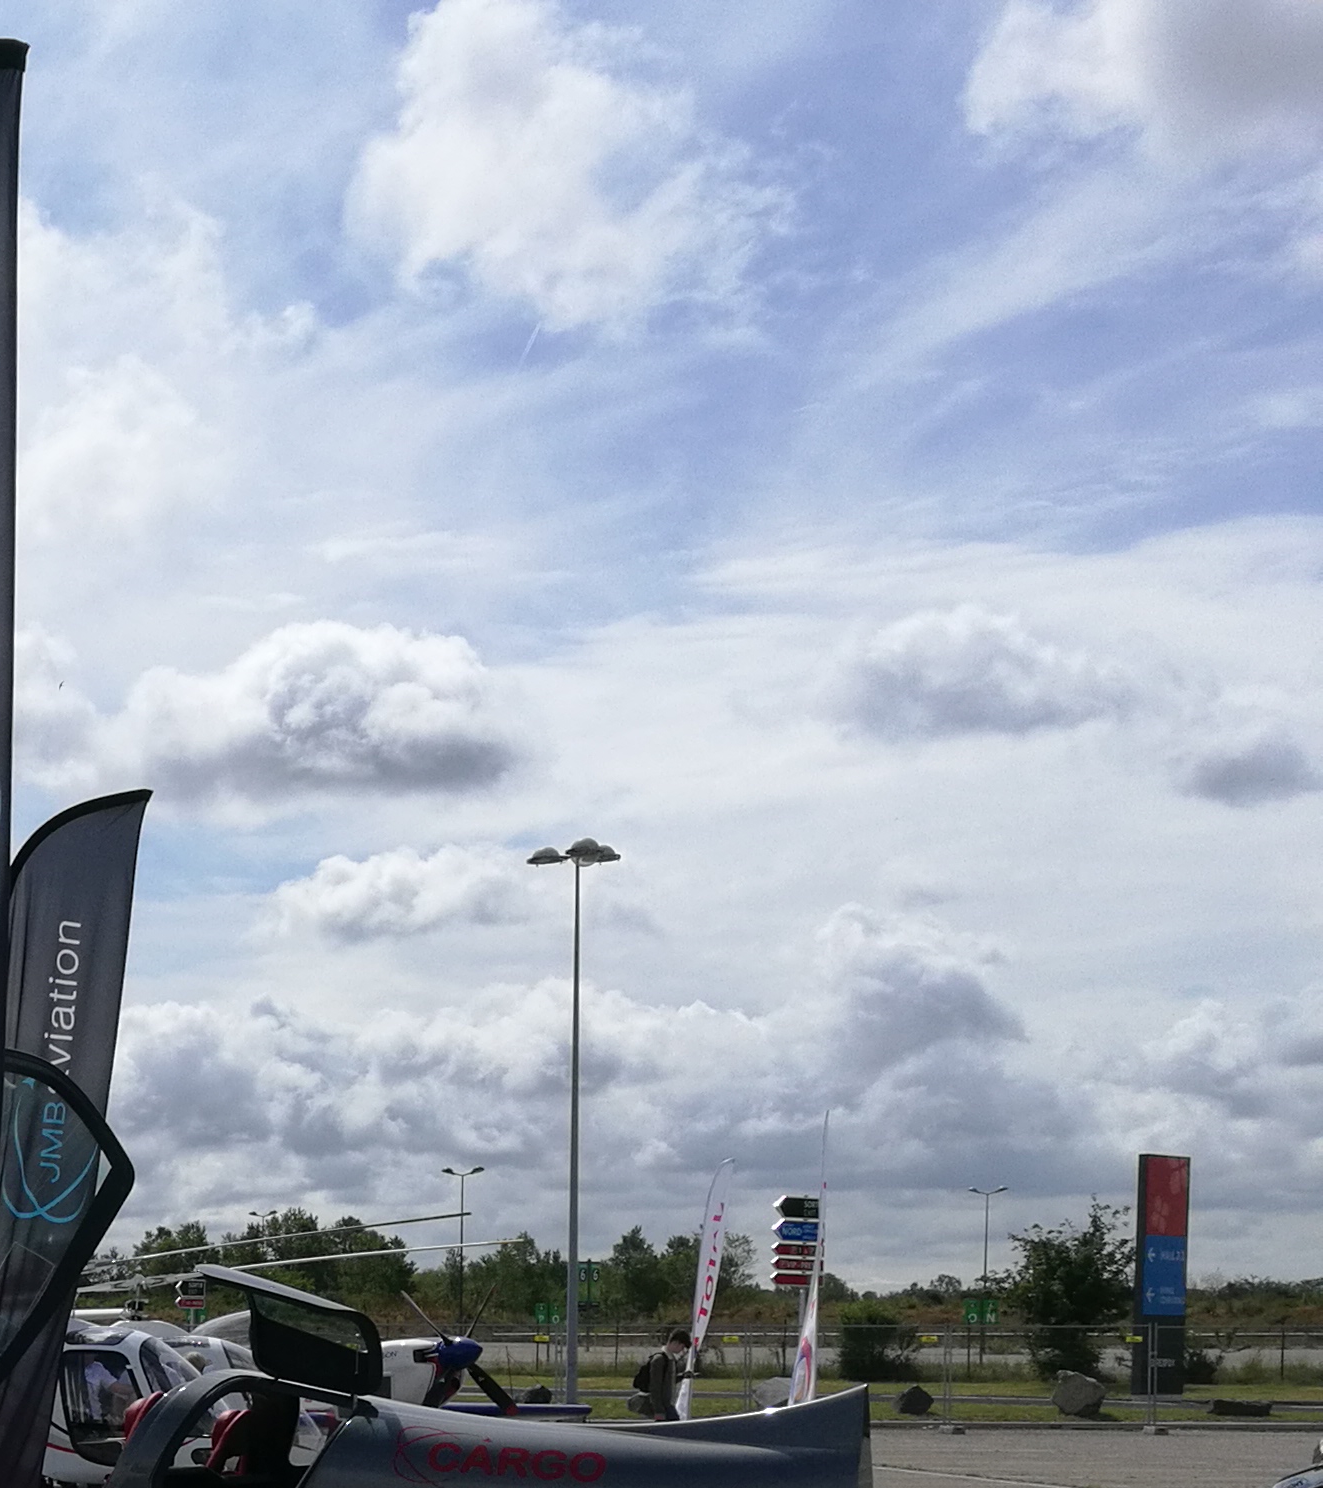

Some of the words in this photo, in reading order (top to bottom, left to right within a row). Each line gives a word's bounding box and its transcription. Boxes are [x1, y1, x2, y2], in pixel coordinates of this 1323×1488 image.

[38, 919, 83, 1184] JMBviation
[580, 1269, 586, 1281] 6
[593, 1269, 599, 1281] 6
[986, 1313, 995, 1322] N
[428, 1442, 607, 1483] CARGO
